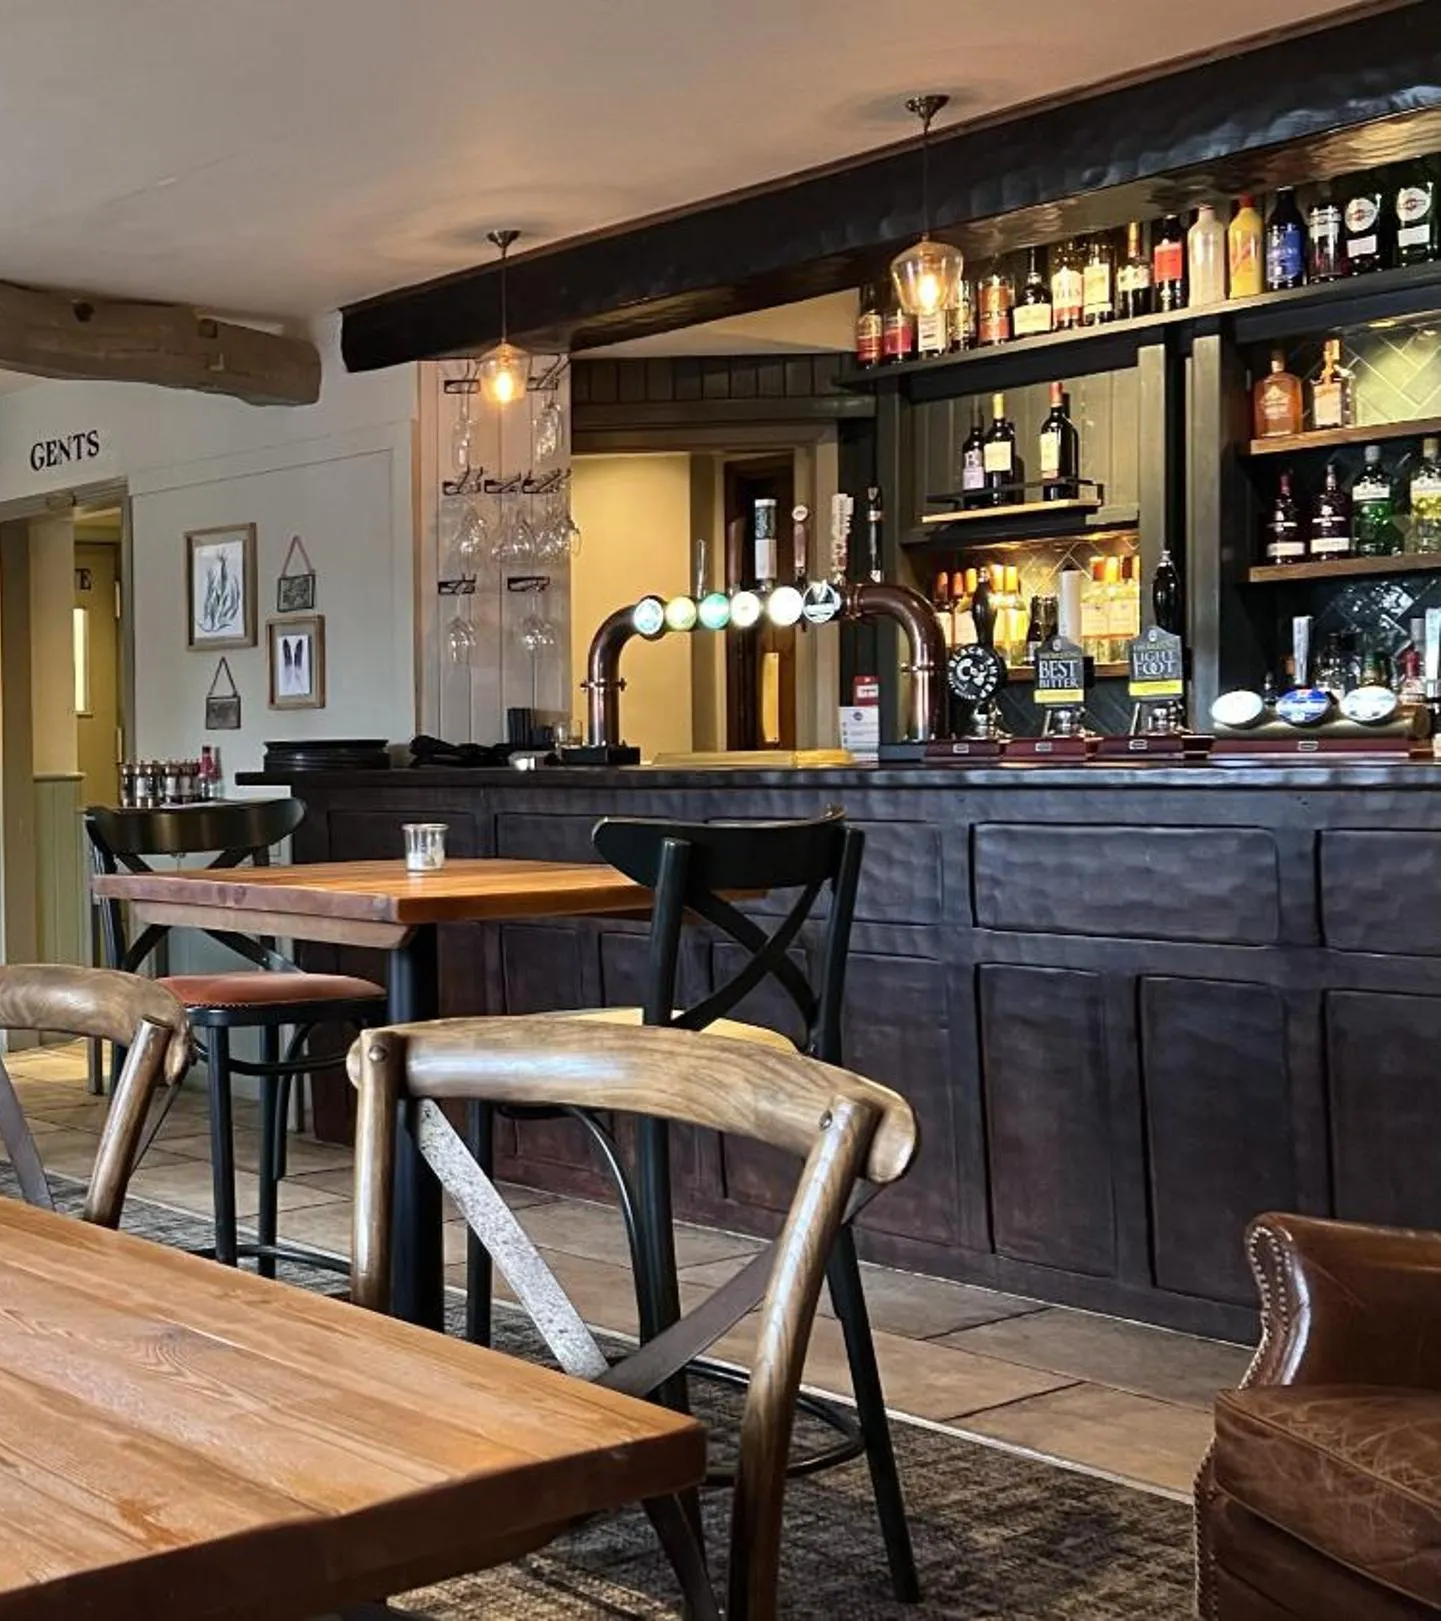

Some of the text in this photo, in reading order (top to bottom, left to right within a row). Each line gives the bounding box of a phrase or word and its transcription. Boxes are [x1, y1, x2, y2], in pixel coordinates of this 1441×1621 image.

[31, 430, 100, 471] GENTS
[1039, 659, 1079, 679] BEST
[1134, 660, 1175, 677] FOOT
[1039, 678, 1079, 688] BITTER
